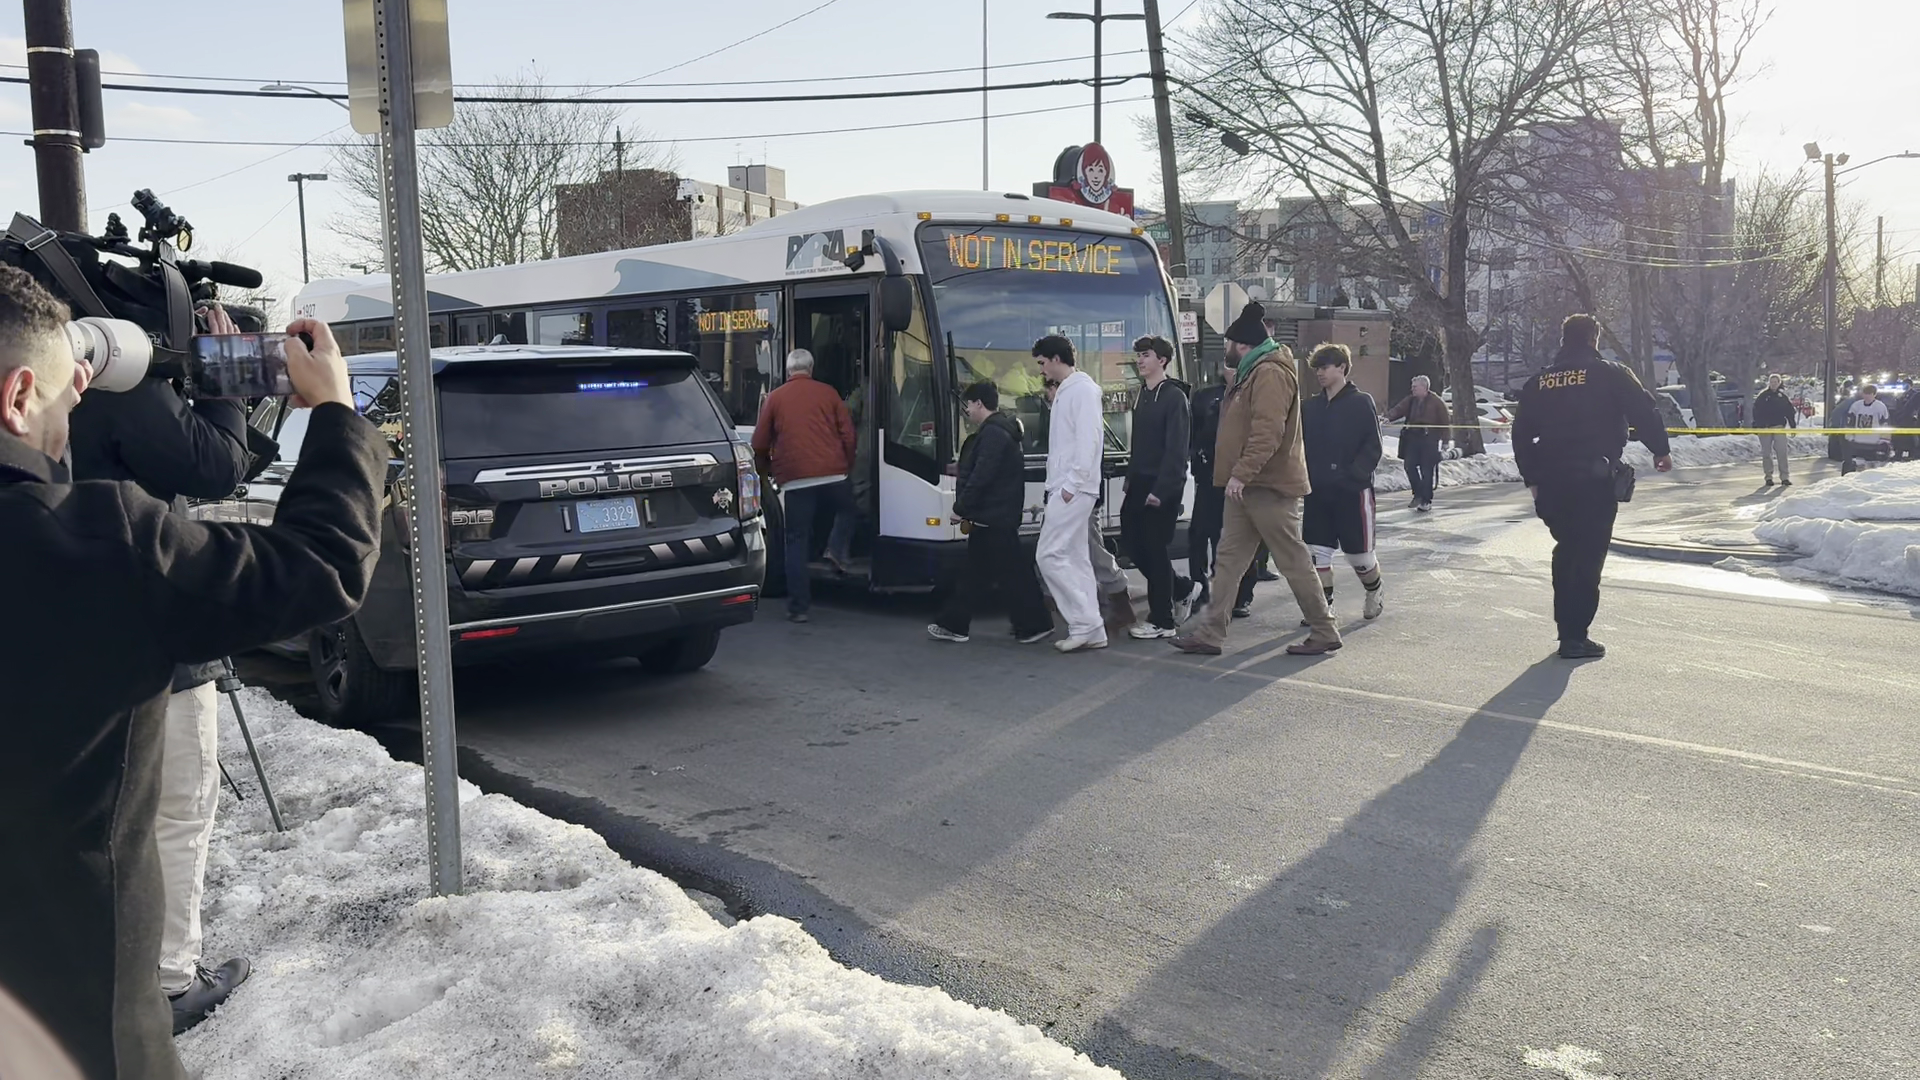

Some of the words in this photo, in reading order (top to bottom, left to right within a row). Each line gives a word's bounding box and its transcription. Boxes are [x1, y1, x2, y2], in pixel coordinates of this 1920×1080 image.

[949, 234, 996, 269] NOT
[1003, 237, 1021, 269] IN
[1028, 239, 1122, 275] SERVICE
[699, 312, 717, 331] NOT
[720, 311, 731, 331] IN
[1539, 369, 1587, 380] LINCOLN
[1539, 374, 1586, 390] POLICE
[539, 471, 673, 498] POLICE
[452, 509, 494, 526] 512
[602, 505, 634, 523] 3329
